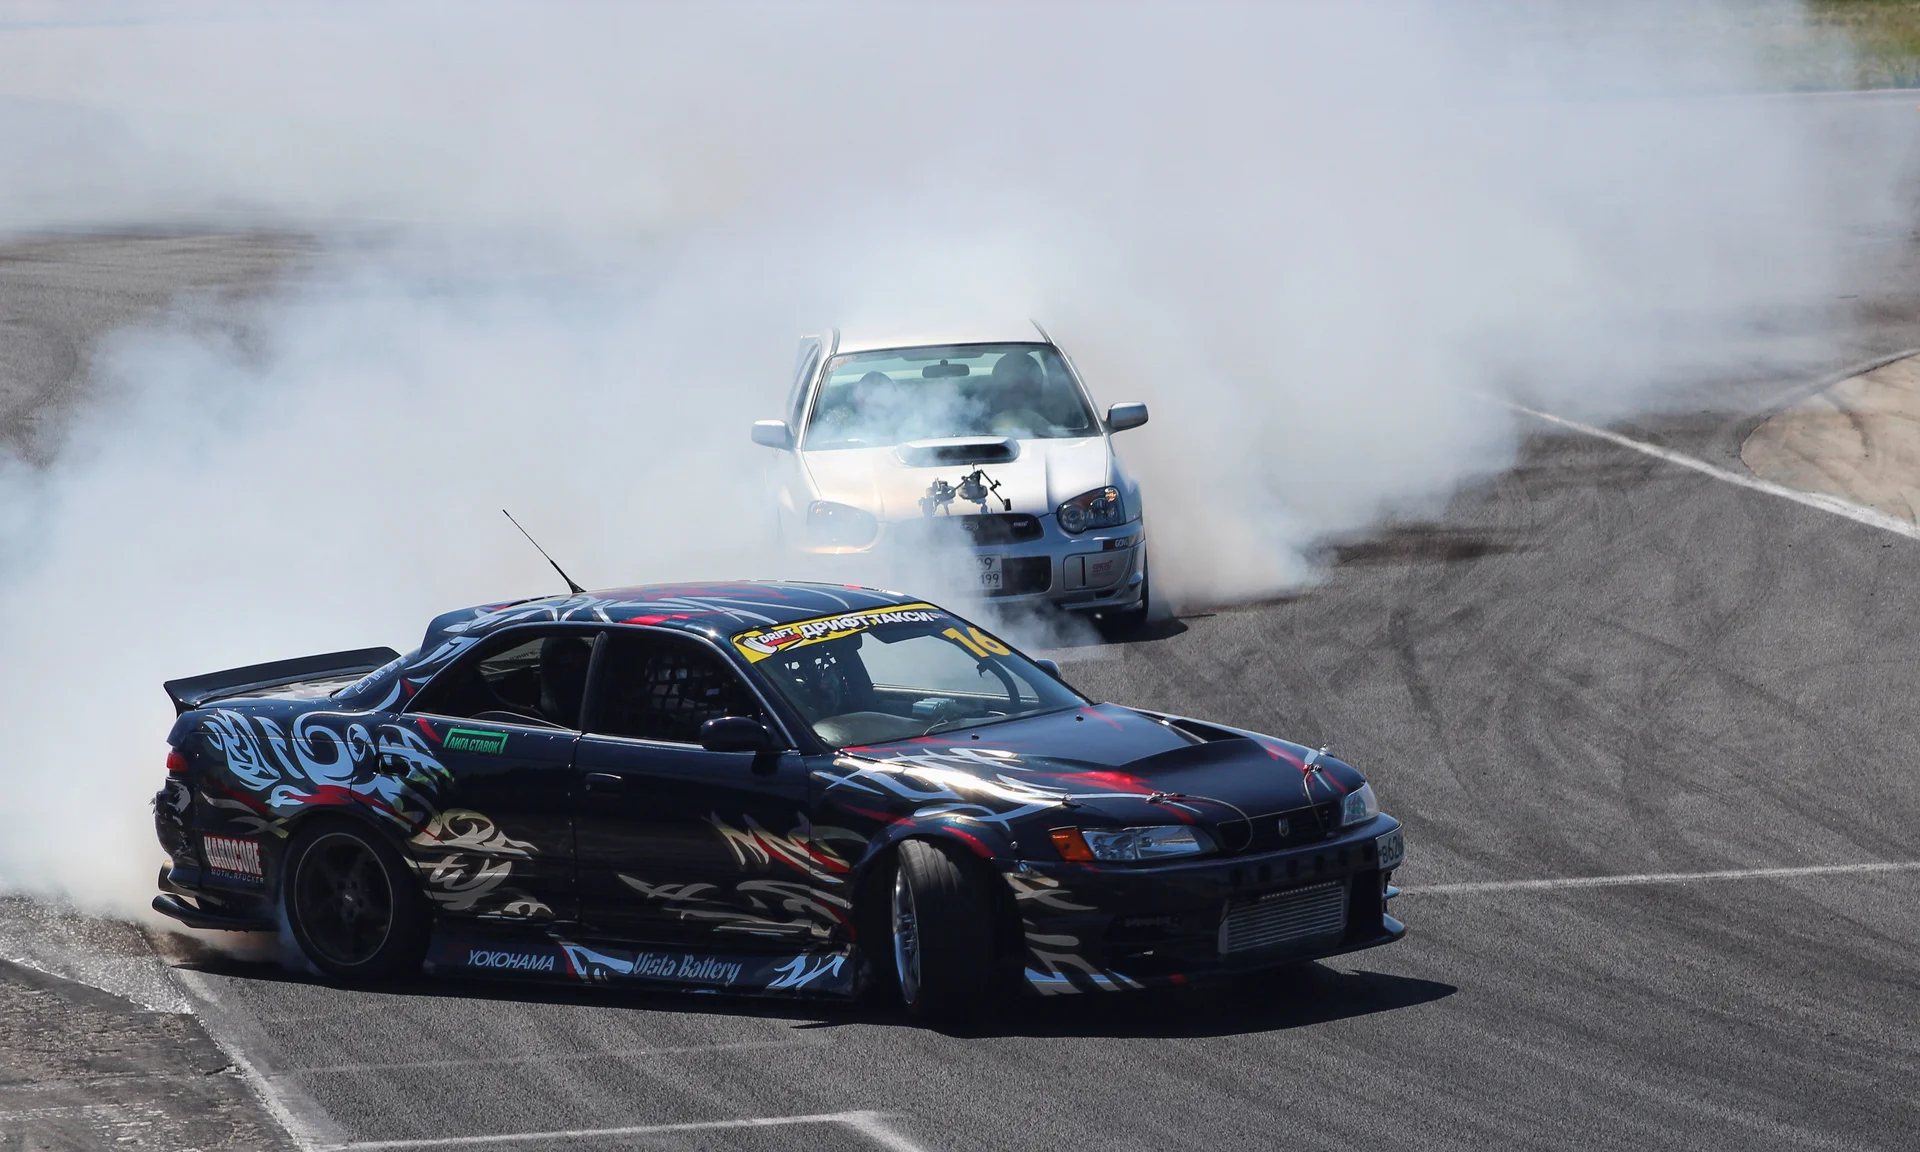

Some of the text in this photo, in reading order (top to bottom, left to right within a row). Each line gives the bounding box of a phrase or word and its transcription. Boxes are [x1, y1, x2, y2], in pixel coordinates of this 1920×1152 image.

[981, 573, 999, 585] 199
[758, 628, 795, 644] DRIFT
[799, 615, 870, 639] ДРИФТ
[867, 611, 935, 625] ТАКСИ
[942, 627, 1010, 658] 16
[448, 736, 501, 754] ЛИГА СТАВОК
[204, 836, 262, 875] HARDCORE
[467, 949, 555, 971] YOKOHAMA
[676, 953, 743, 987] Battery
